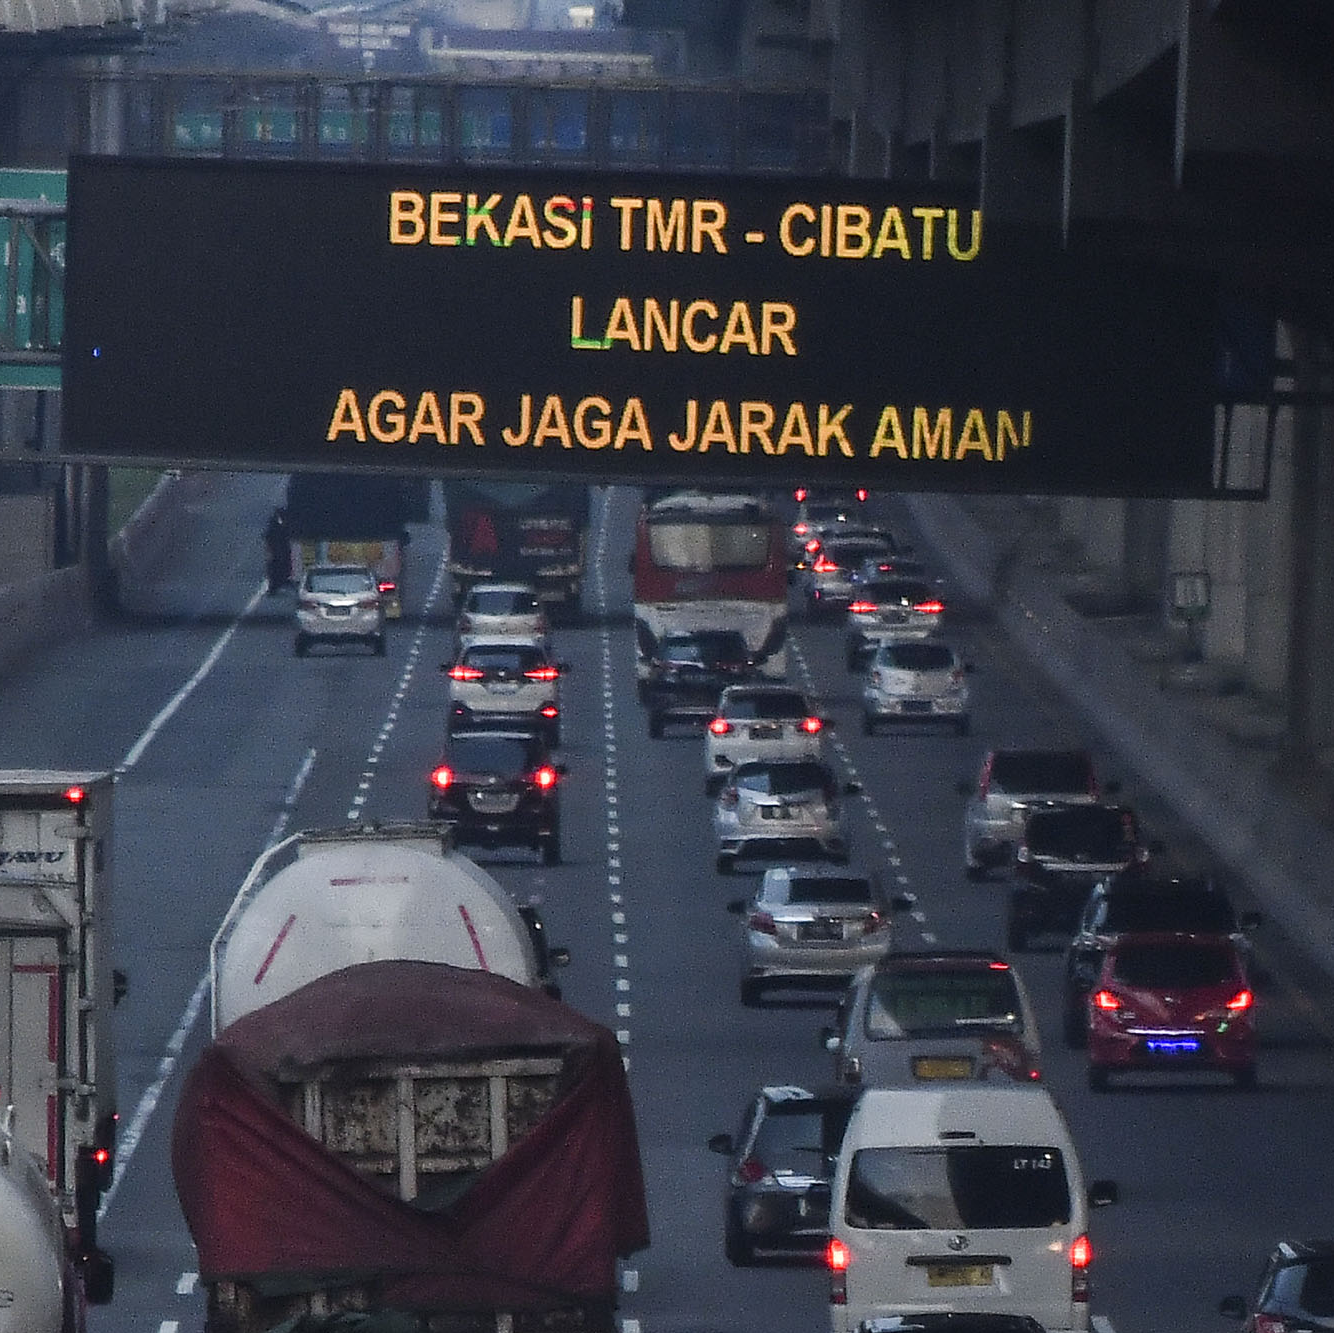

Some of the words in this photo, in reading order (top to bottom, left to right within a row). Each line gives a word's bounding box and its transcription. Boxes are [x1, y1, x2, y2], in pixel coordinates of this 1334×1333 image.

[389, 191, 594, 251] BEKASI
[610, 197, 729, 255] TMR
[779, 203, 982, 262] CIBATU
[570, 295, 799, 357] LANCAR
[325, 387, 486, 446] AGAR
[501, 393, 654, 452] JAGA
[667, 399, 856, 458] JARAK
[868, 404, 1033, 462] AMAN
